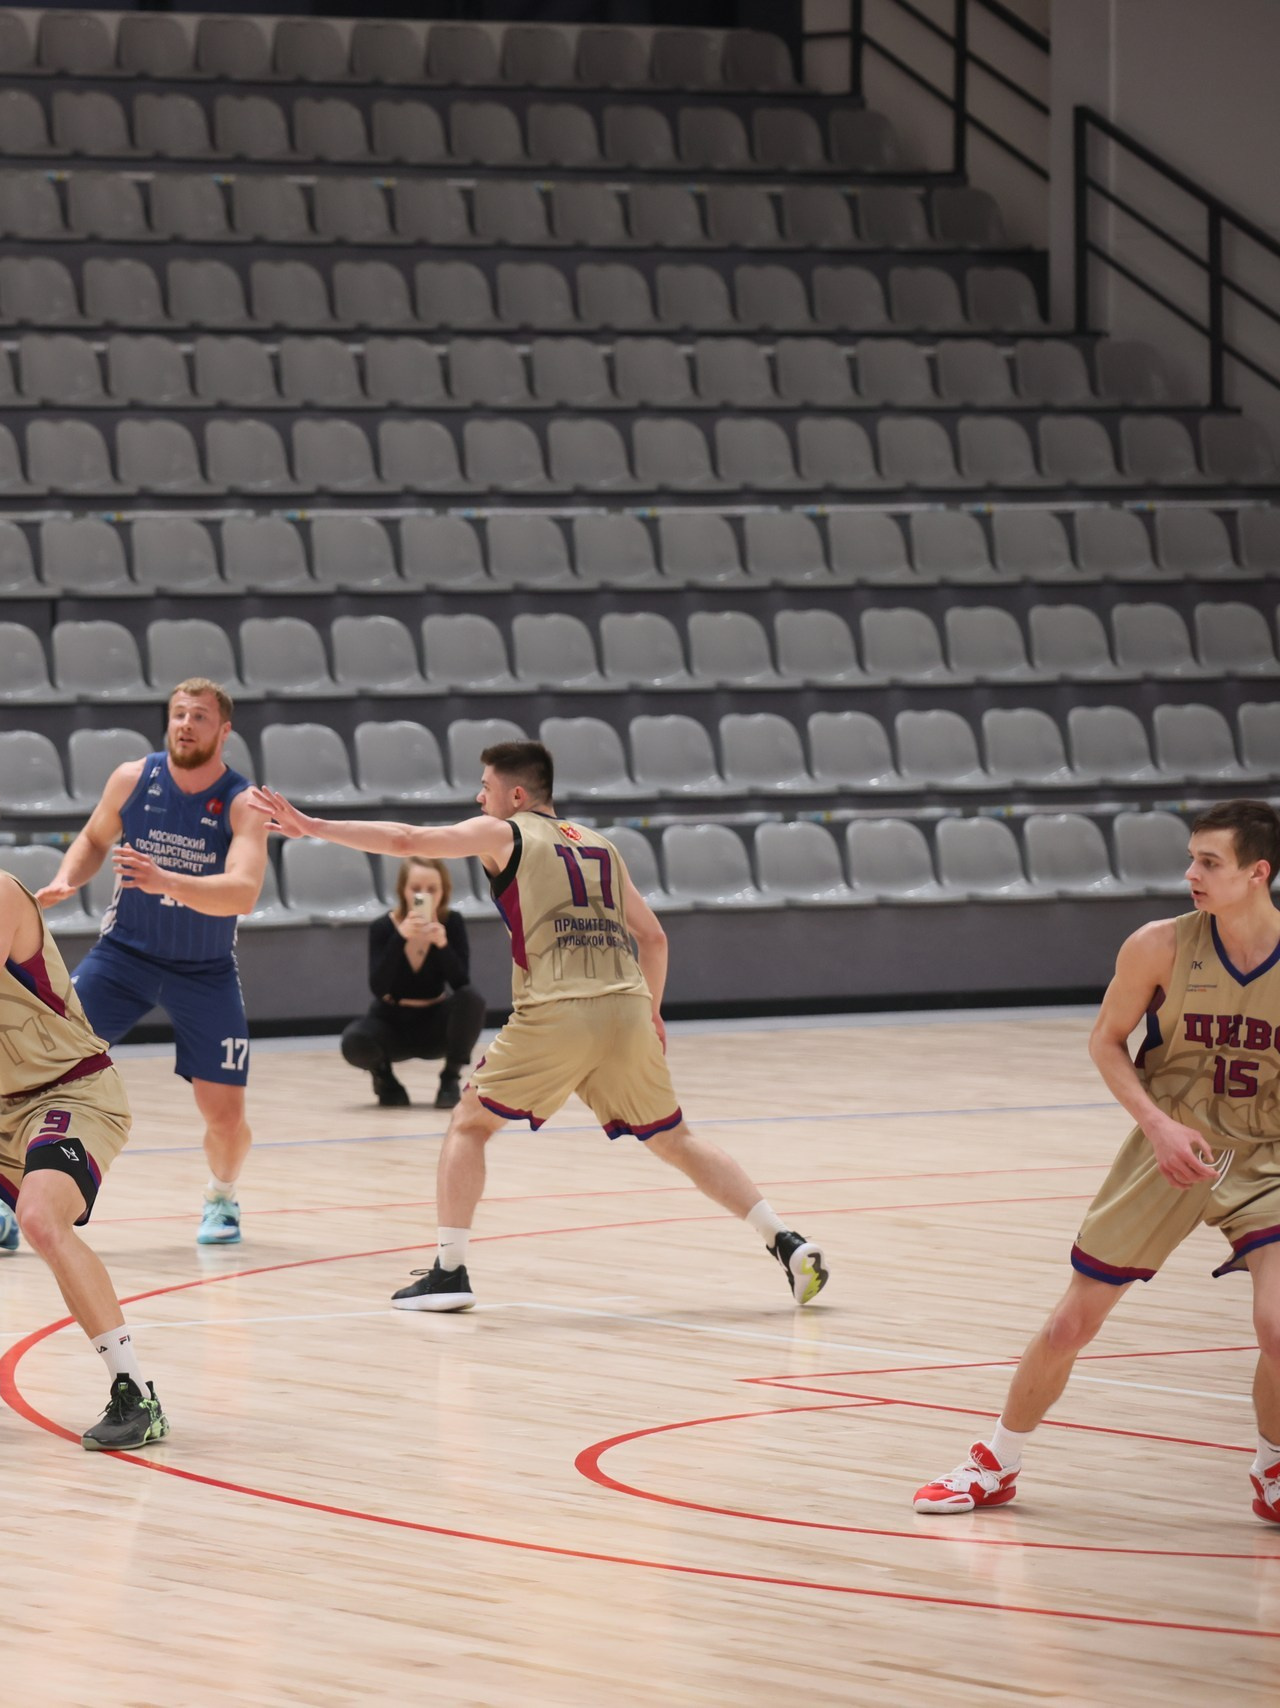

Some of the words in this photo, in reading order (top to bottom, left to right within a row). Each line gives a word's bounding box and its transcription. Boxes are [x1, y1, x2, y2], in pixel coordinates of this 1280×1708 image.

[135, 838, 217, 864] ГОСУДАРСТВЕННЫЙ
[148, 828, 206, 851] МОСКОВСКИЙ
[147, 852, 204, 873] НИВЕРСИТЕТ
[554, 844, 615, 910] 17
[554, 918, 621, 933] ПРАВИТЕЛЬ
[557, 933, 604, 948] ТУЛЬСКОЙ
[1183, 1013, 1280, 1054] ЦИВ
[221, 1037, 248, 1070] 17
[1213, 1055, 1260, 1098] 15
[39, 1110, 72, 1134] 9
